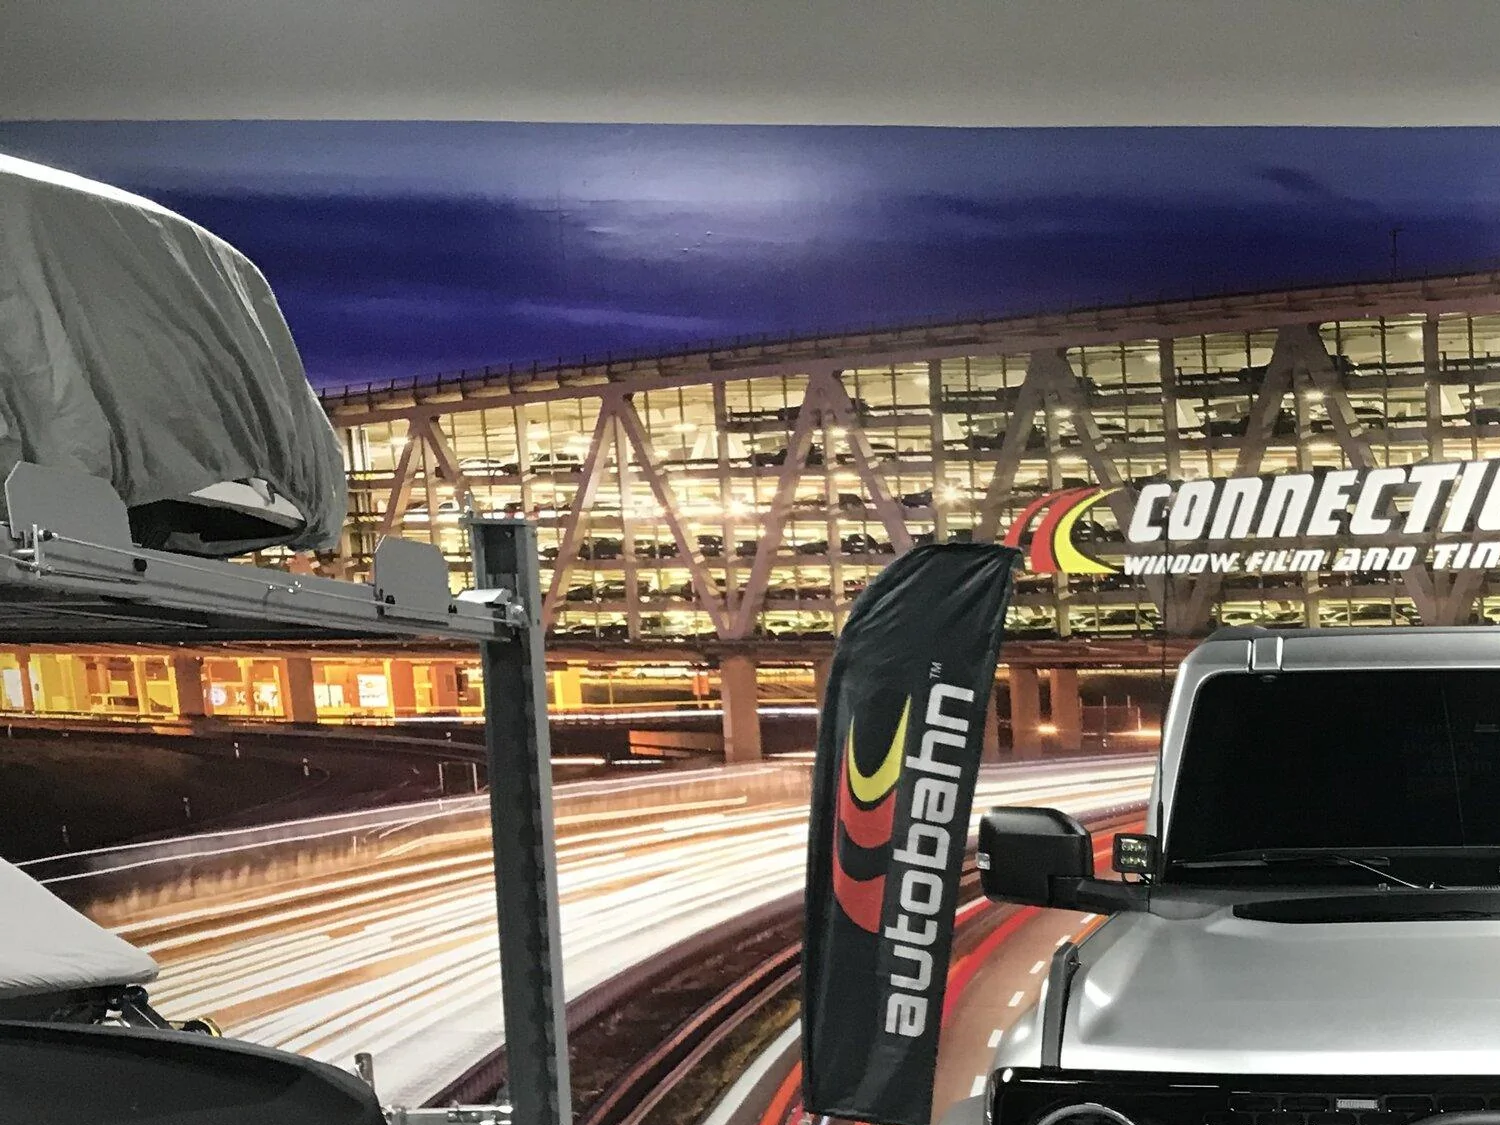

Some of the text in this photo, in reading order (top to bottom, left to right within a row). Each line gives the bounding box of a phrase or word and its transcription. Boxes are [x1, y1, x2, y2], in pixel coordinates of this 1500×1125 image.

[1123, 552, 1240, 576] WINDOW
[1246, 549, 1321, 573] FILM
[1333, 546, 1418, 572] AND
[884, 681, 975, 1038] autobahn
